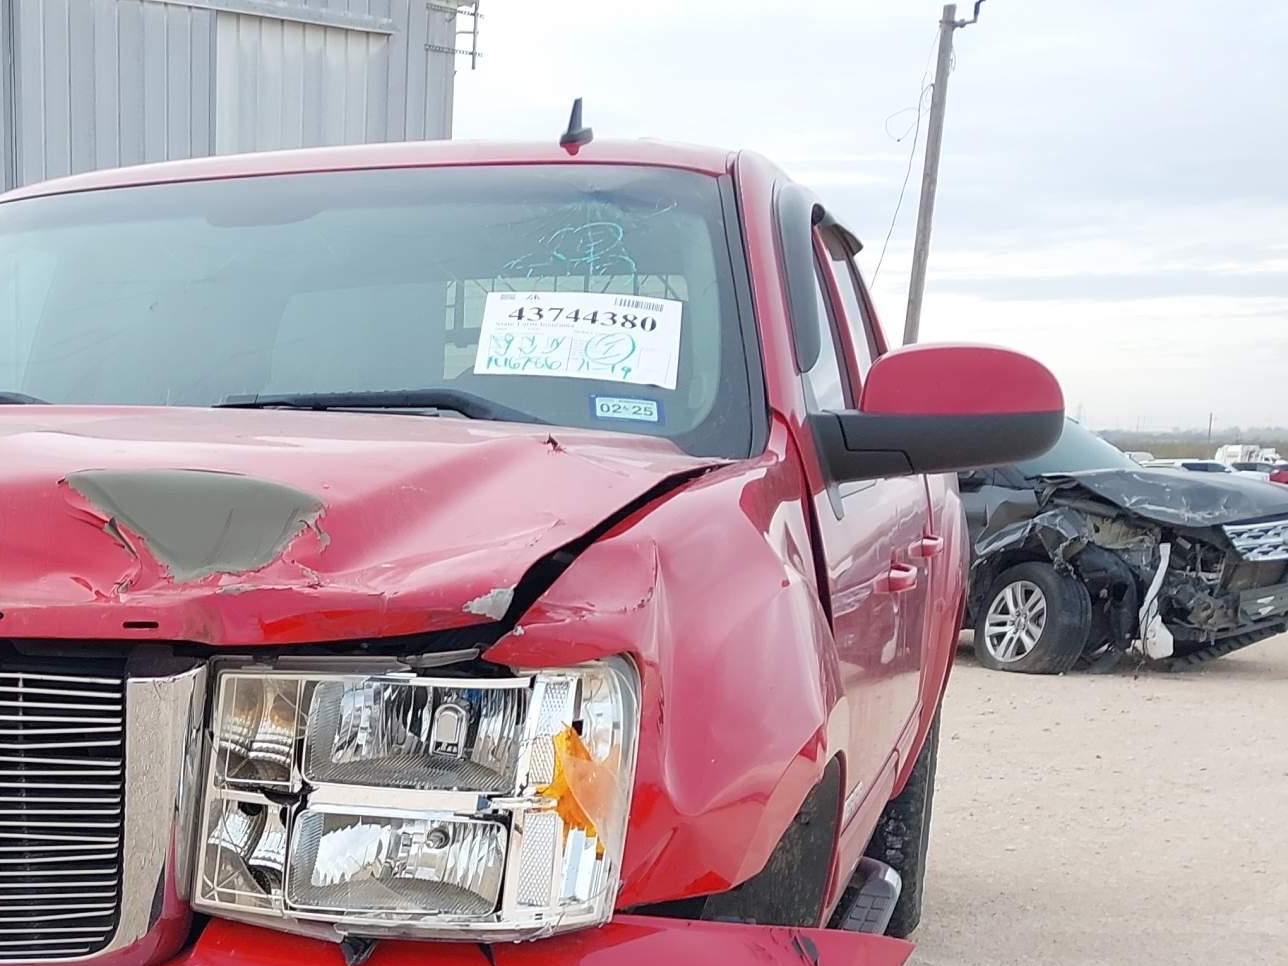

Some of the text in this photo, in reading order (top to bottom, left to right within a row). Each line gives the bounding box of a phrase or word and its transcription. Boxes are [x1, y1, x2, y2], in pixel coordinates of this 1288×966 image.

[508, 306, 657, 332] 43744380
[600, 403, 654, 416] 02 25
